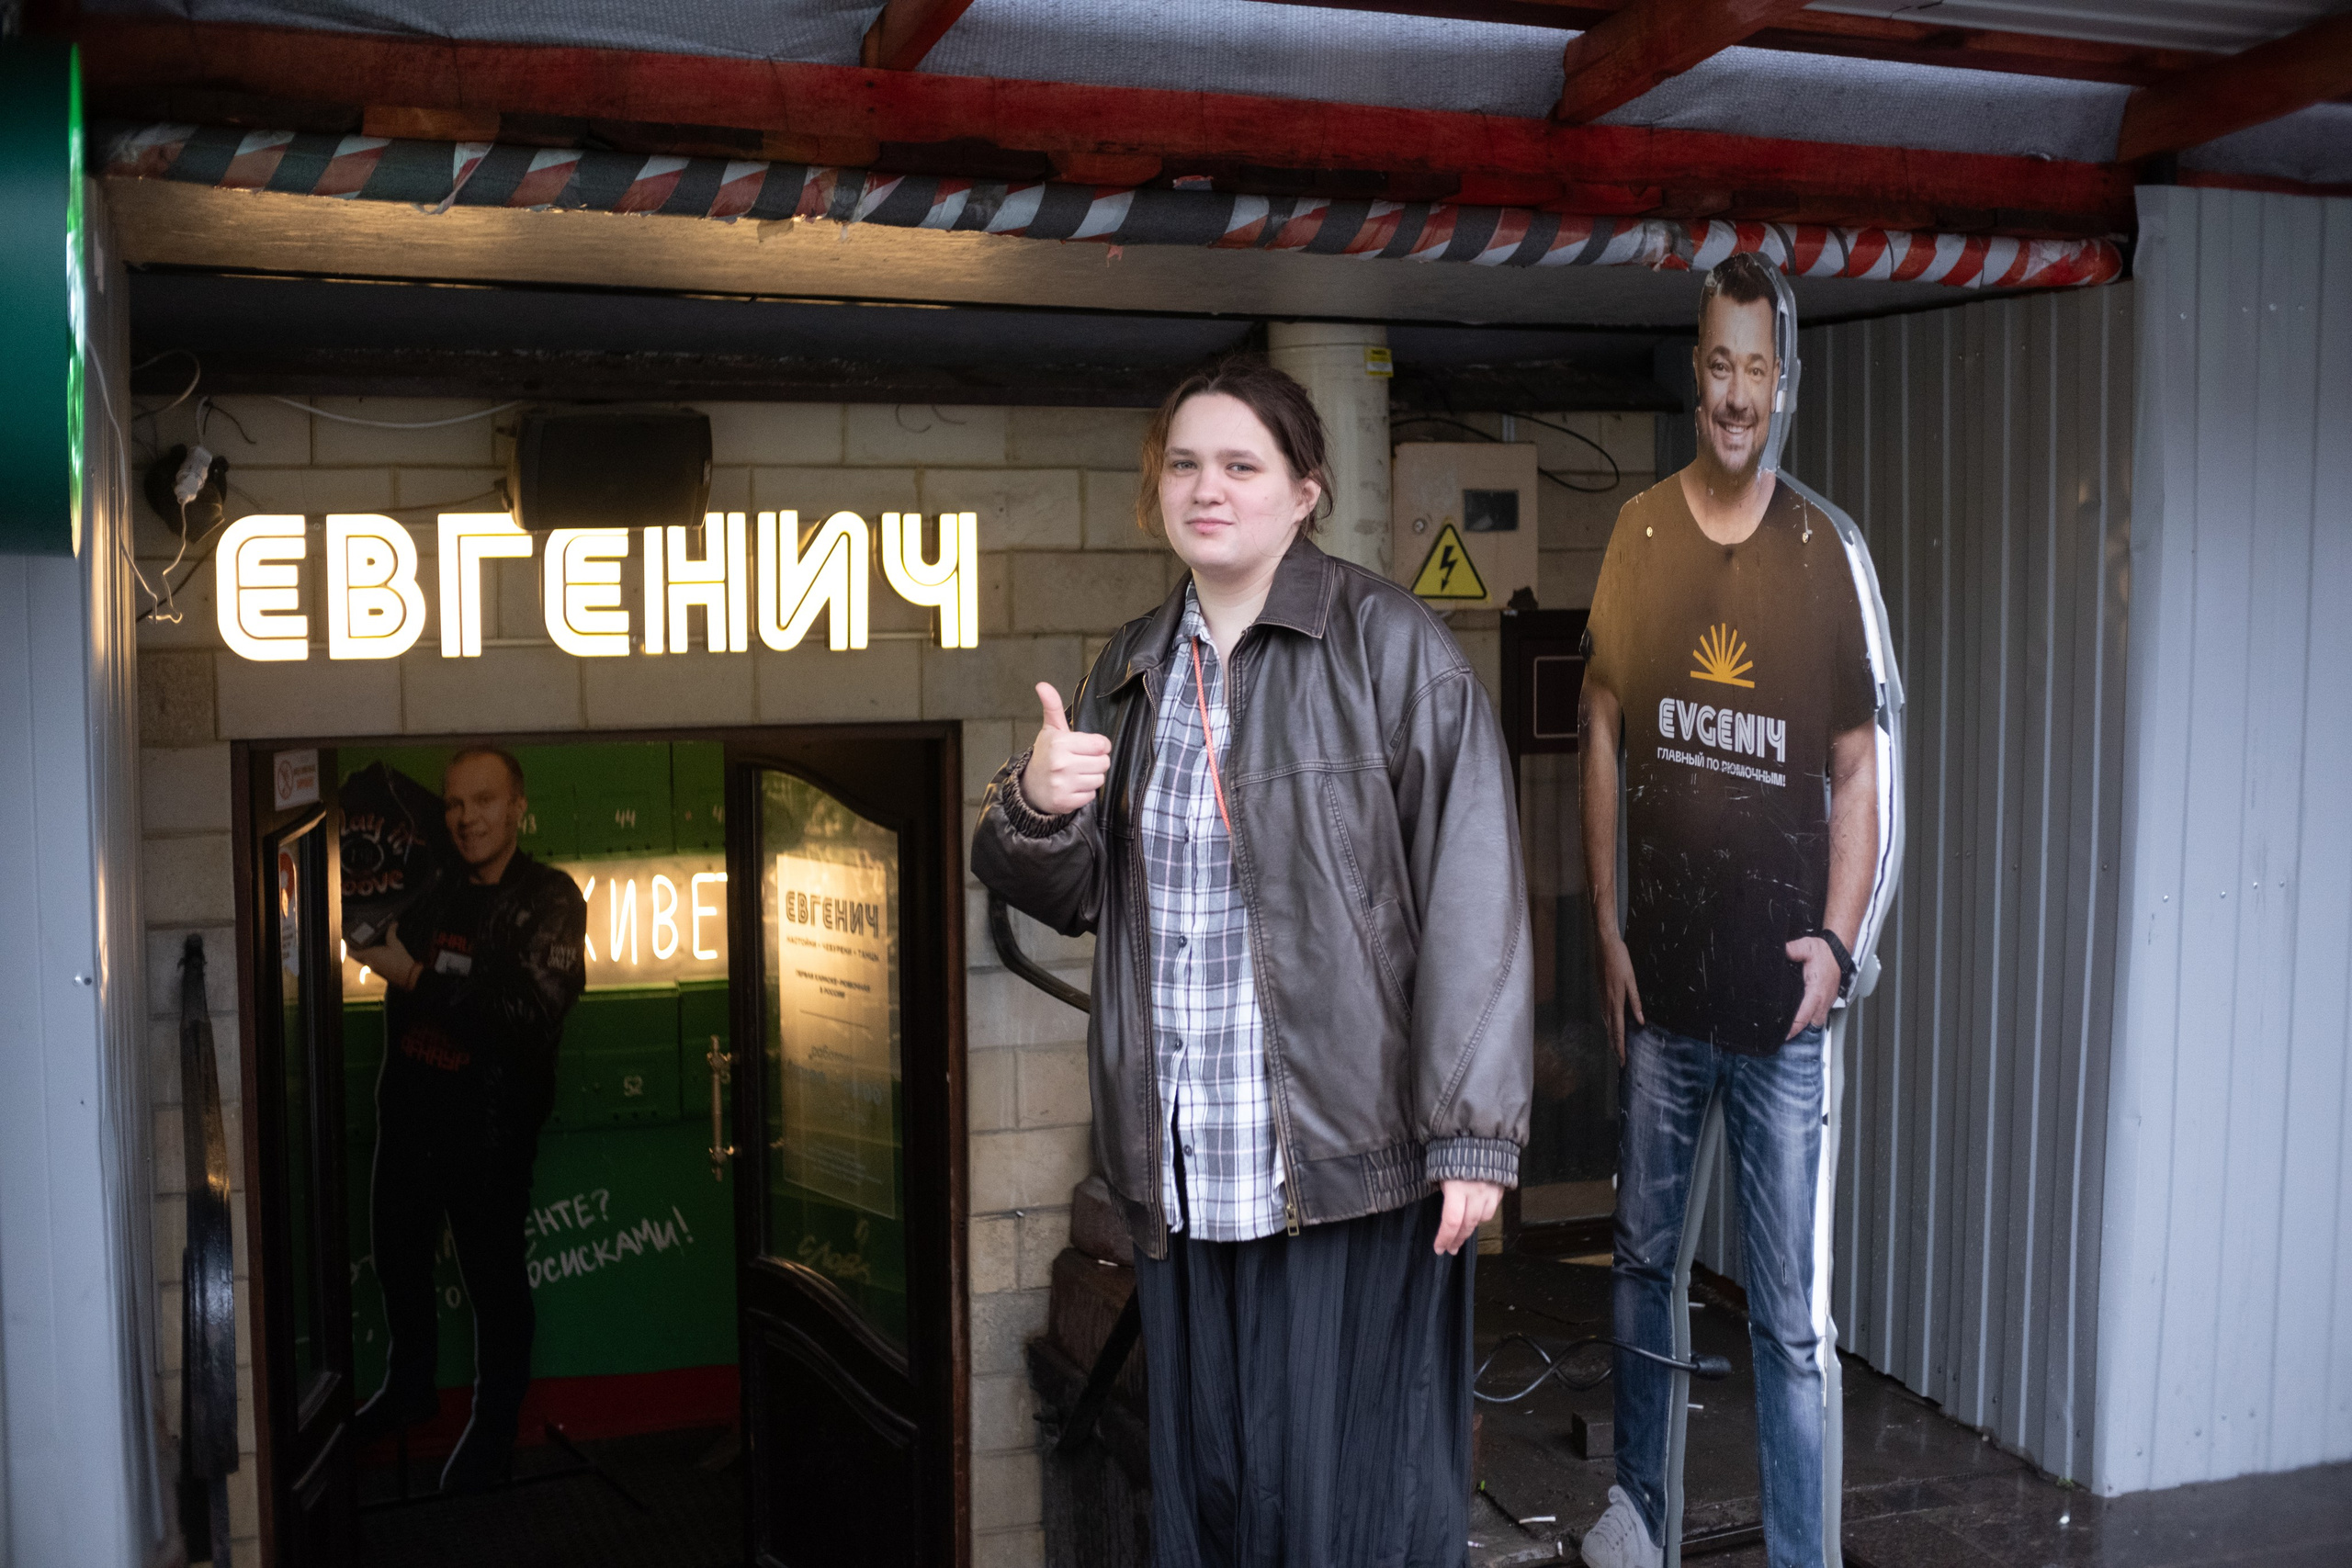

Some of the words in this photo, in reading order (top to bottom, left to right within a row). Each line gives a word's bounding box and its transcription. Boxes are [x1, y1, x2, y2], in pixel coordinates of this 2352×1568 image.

[216, 510, 978, 661] ЕВГЕНИЧ
[1657, 747, 1705, 768] ГЛАВНЫЙ
[1706, 757, 1720, 771] ПО
[1721, 761, 1786, 787] РЮМОЧНЫМ!
[786, 890, 879, 939] ЕВГЕНИЧ
